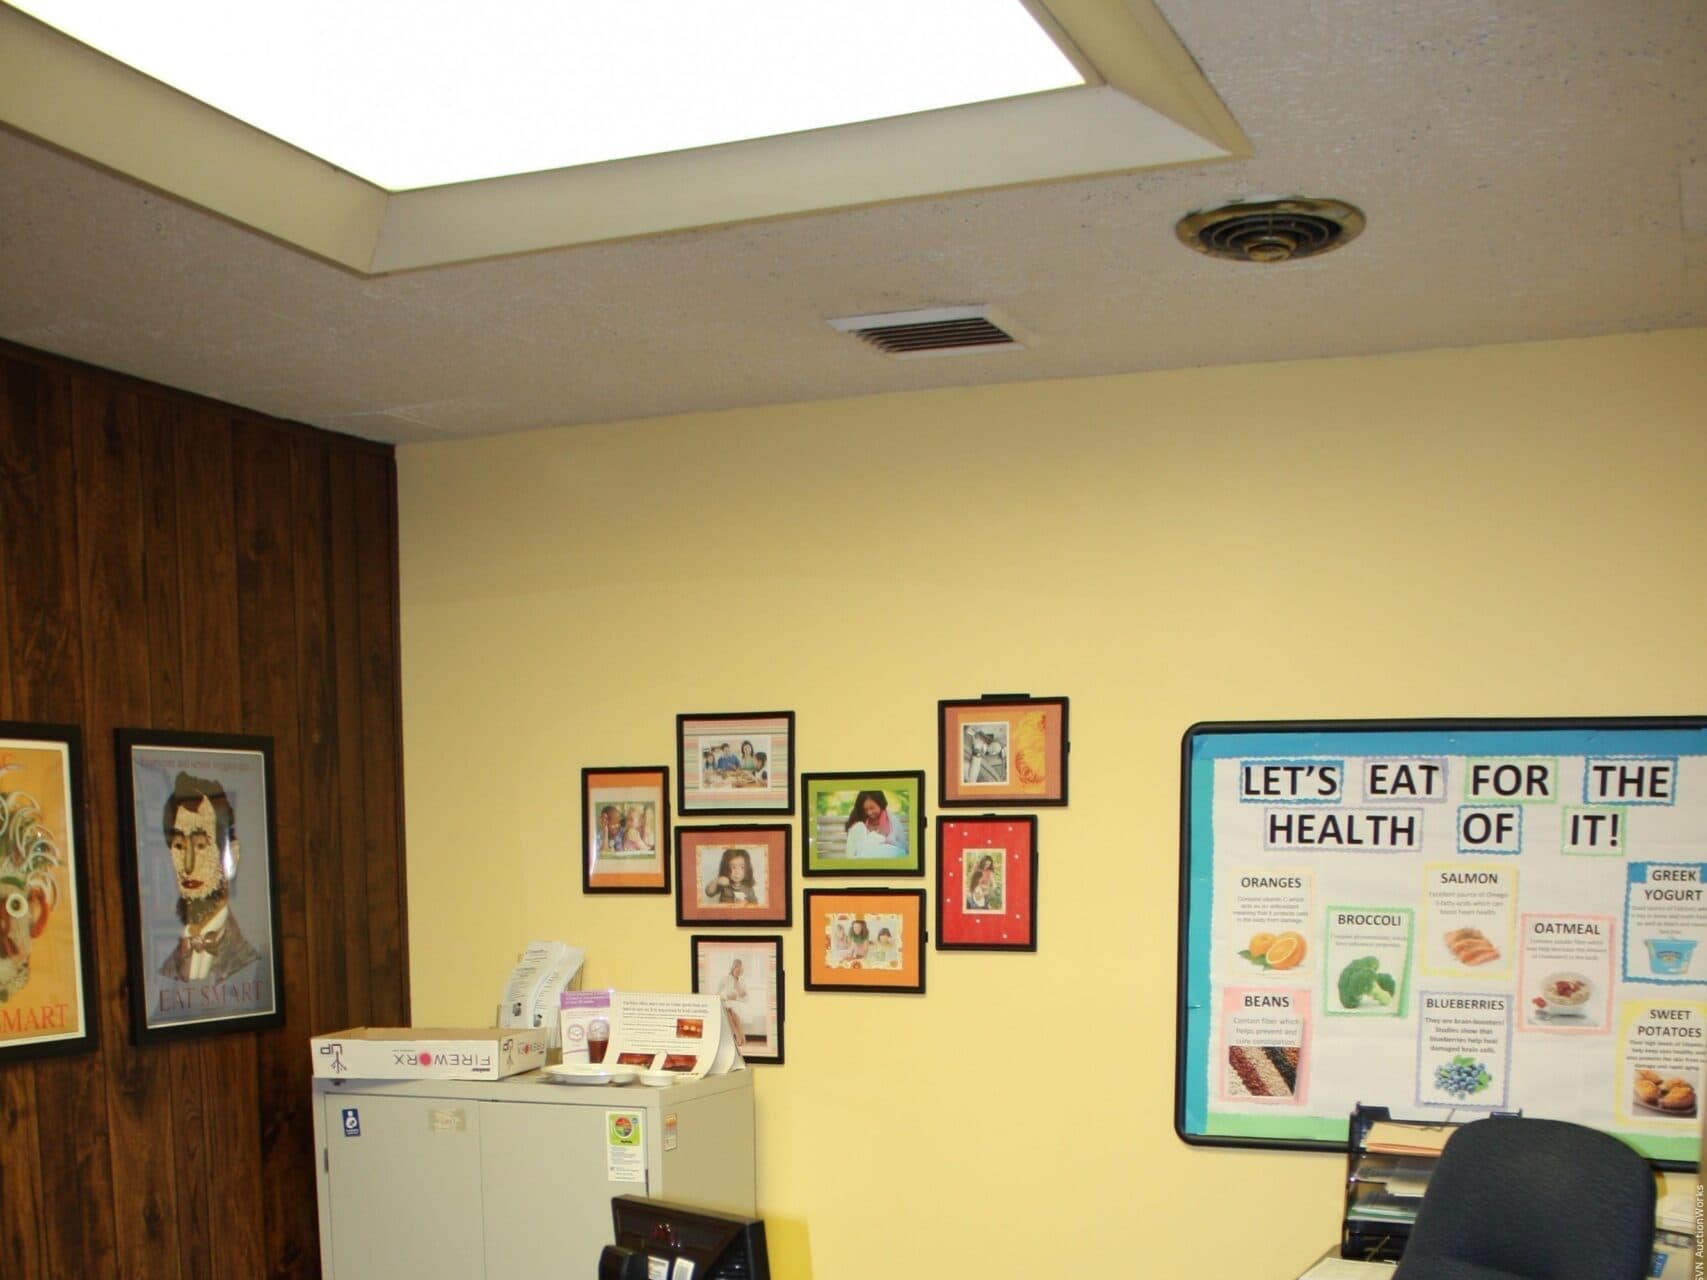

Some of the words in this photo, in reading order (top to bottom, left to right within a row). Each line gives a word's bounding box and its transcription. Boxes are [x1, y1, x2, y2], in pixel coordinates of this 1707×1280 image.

[1243, 766, 1337, 796] LET'S
[1369, 764, 1439, 795] EAT
[1472, 765, 1549, 796] FOR
[1593, 766, 1669, 798] THE
[1269, 815, 1415, 846] HEALTH
[1463, 812, 1516, 844] OF
[1570, 814, 1619, 846] IT!
[1441, 872, 1498, 884] SALMON
[1652, 870, 1696, 881] GREEK
[1240, 877, 1302, 888] ORANGES
[1645, 889, 1703, 901] YOGURT
[1338, 914, 1401, 926] BROCCOLI
[1534, 923, 1600, 935] OATMEAL
[1244, 996, 1290, 1007] BEANS
[1426, 998, 1504, 1010] BLUEBERRIES
[0, 1003, 69, 1033] MART
[1650, 1009, 1692, 1020] SWEET
[1638, 1026, 1702, 1038] POTATOES
